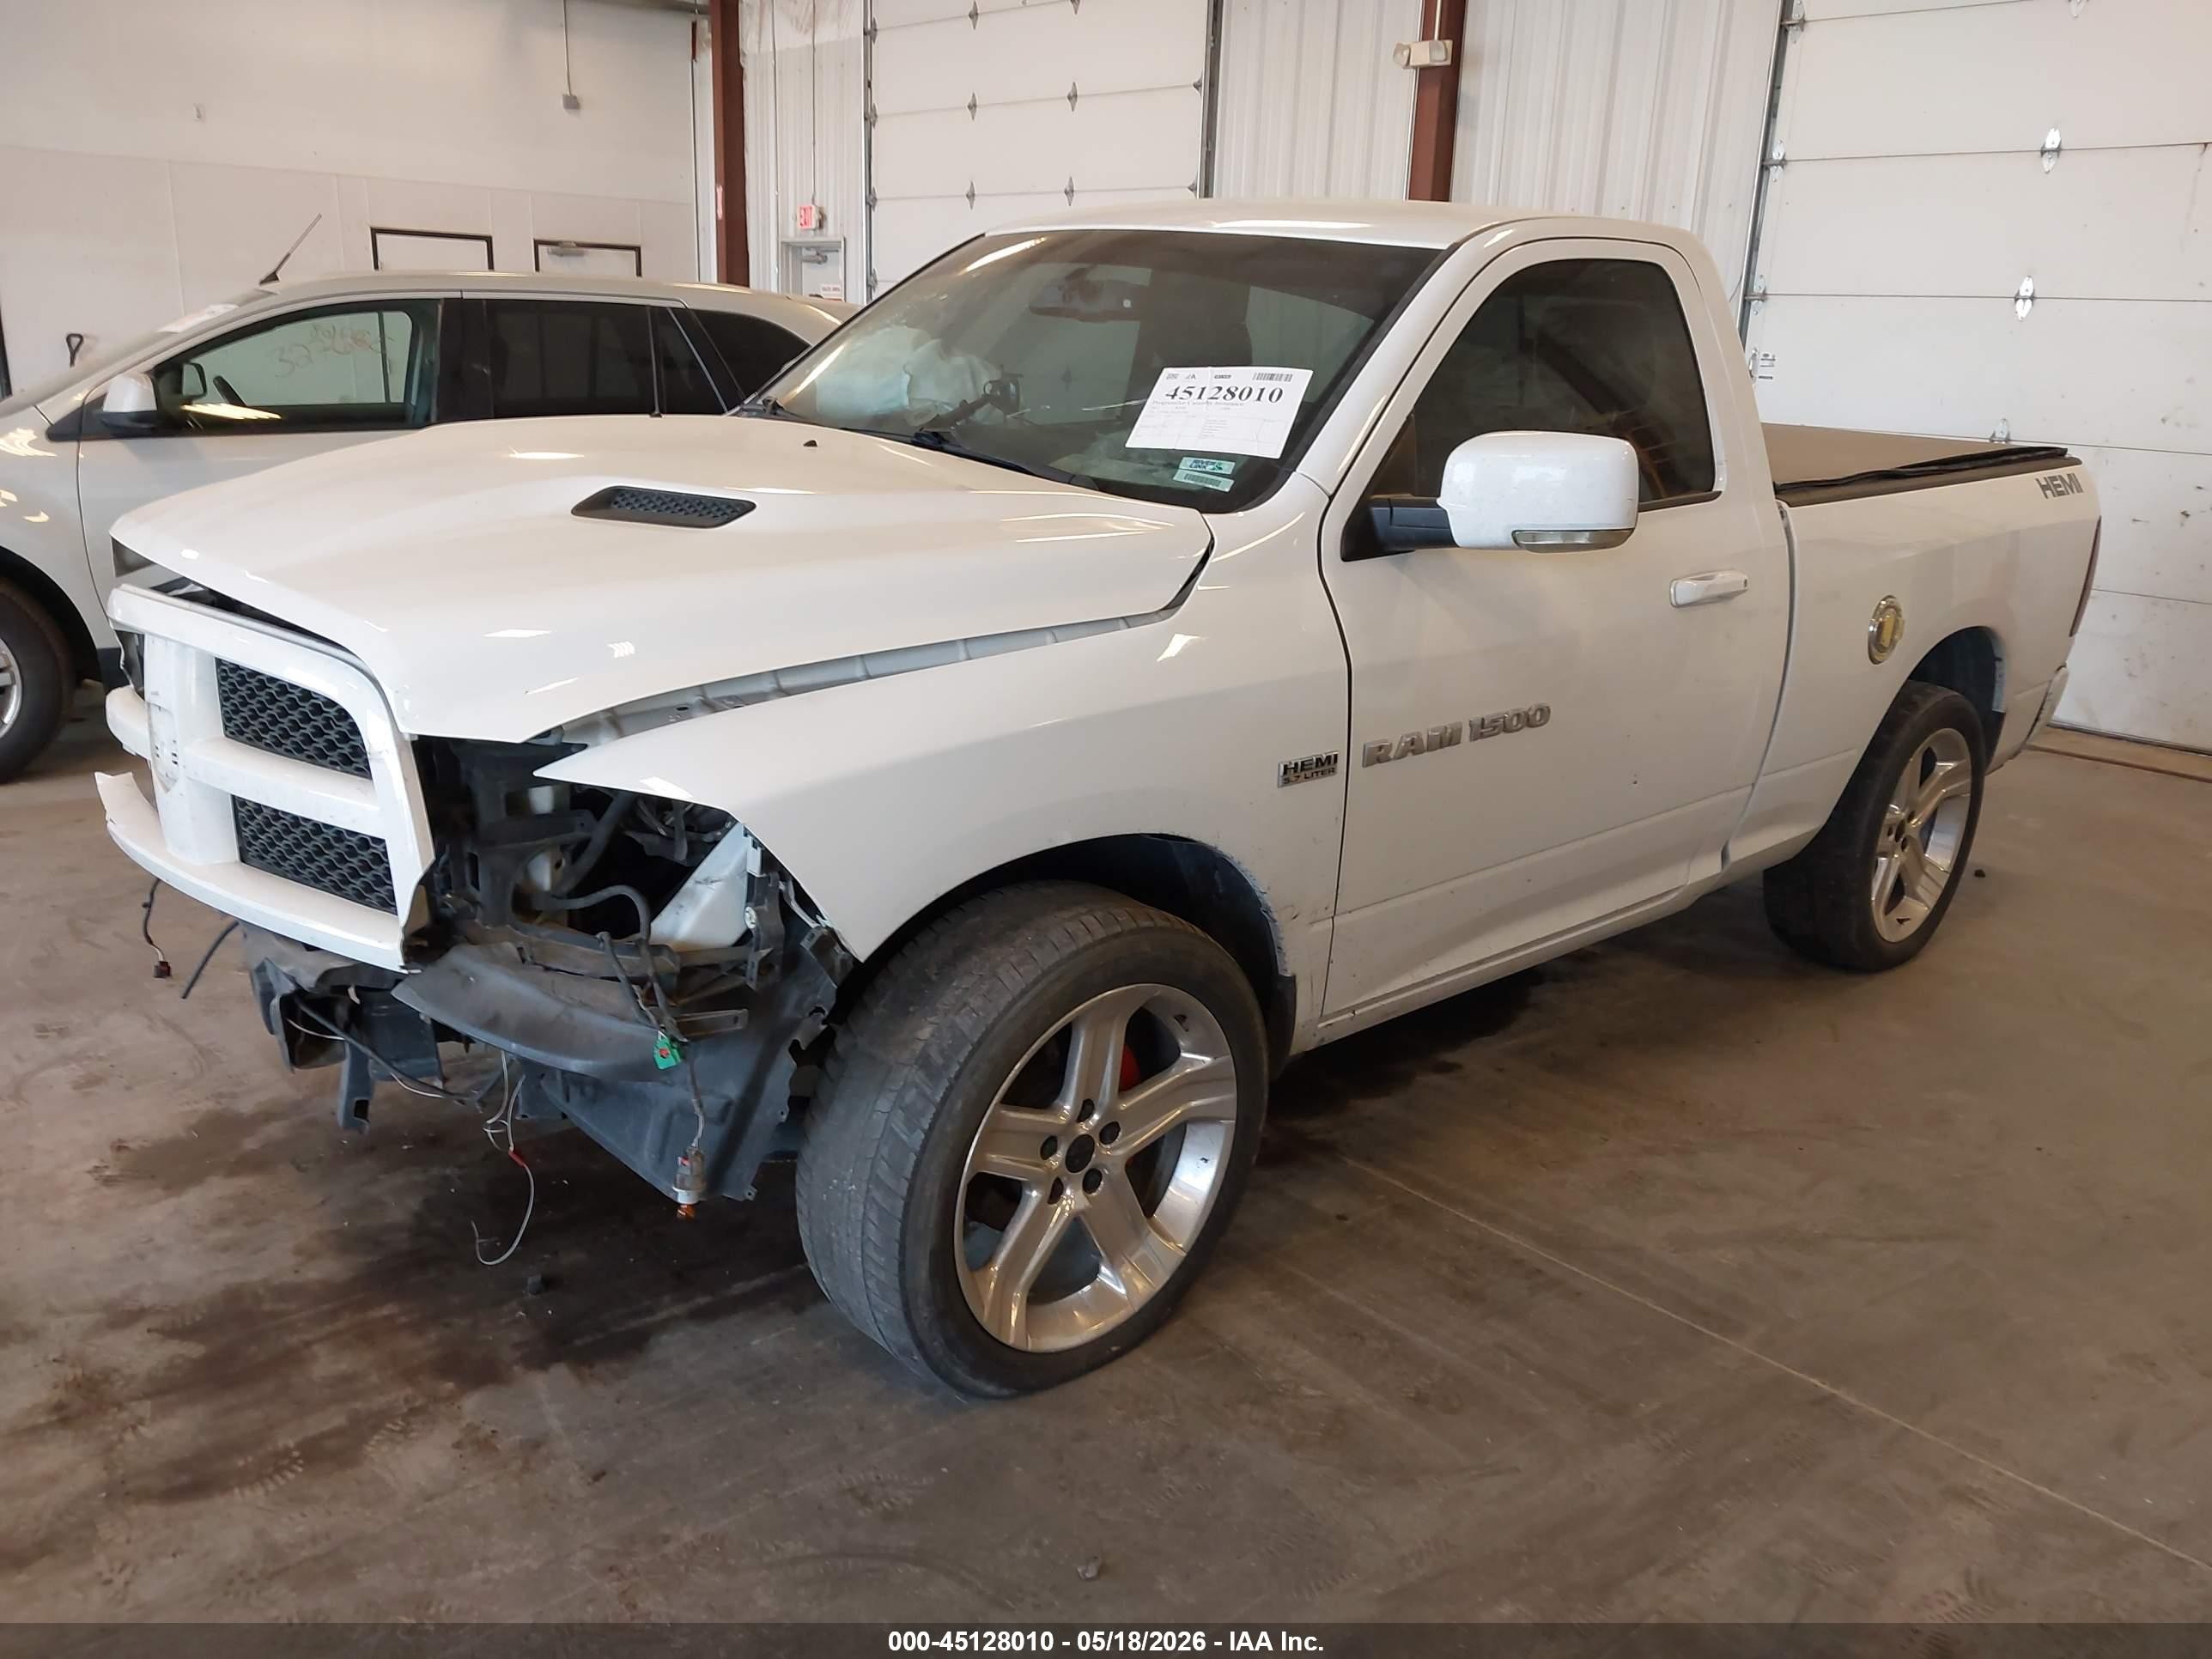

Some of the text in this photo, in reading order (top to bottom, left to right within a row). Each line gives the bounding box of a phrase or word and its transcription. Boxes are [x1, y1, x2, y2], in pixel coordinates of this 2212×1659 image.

[1165, 386, 1283, 403] 45128010
[2035, 473, 2083, 499] HEMI
[1362, 703, 1551, 768] RAM 1500
[1280, 752, 1339, 775] HEMI
[1304, 767, 1335, 780] LITER
